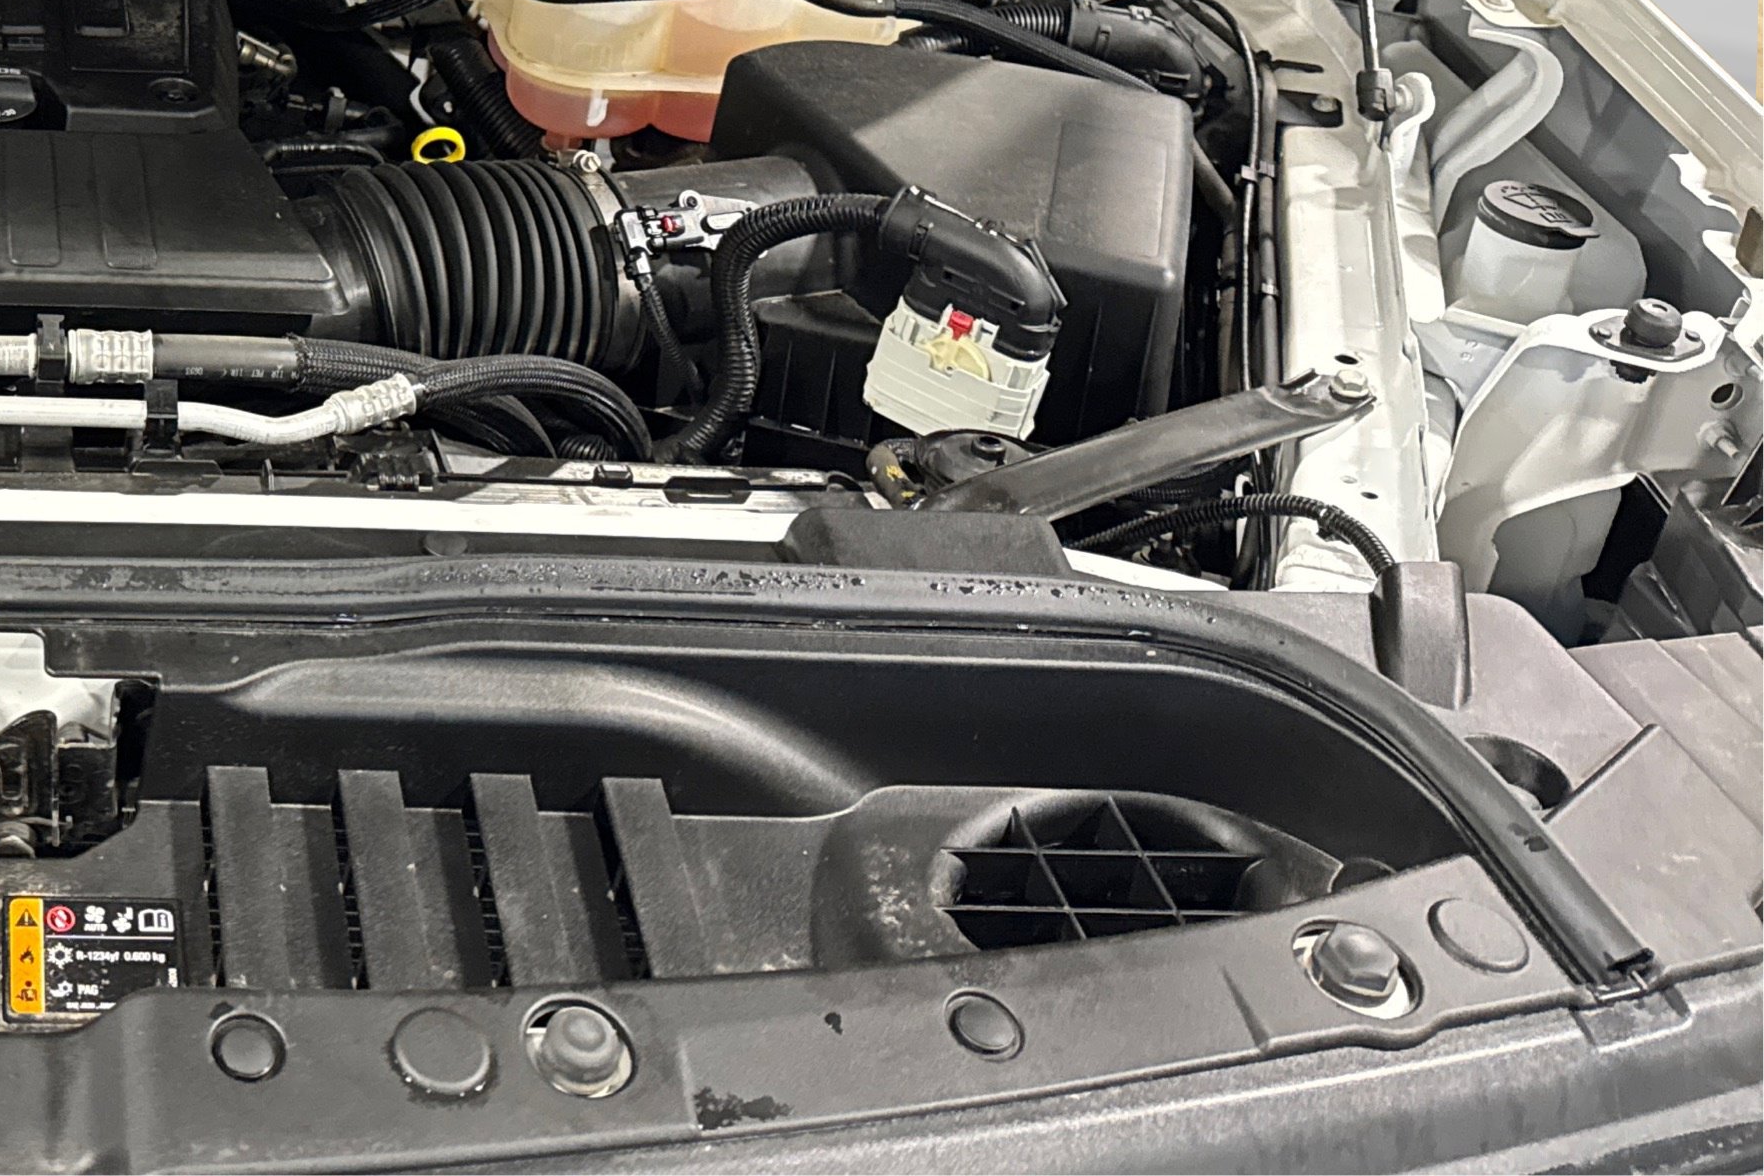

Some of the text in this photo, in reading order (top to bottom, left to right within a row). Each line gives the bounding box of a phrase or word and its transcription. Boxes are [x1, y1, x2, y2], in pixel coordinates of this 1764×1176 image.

[83, 923, 109, 932] AUTO
[76, 950, 120, 963] R-1234yf
[152, 951, 166, 963] kg
[77, 984, 100, 996] PAG
